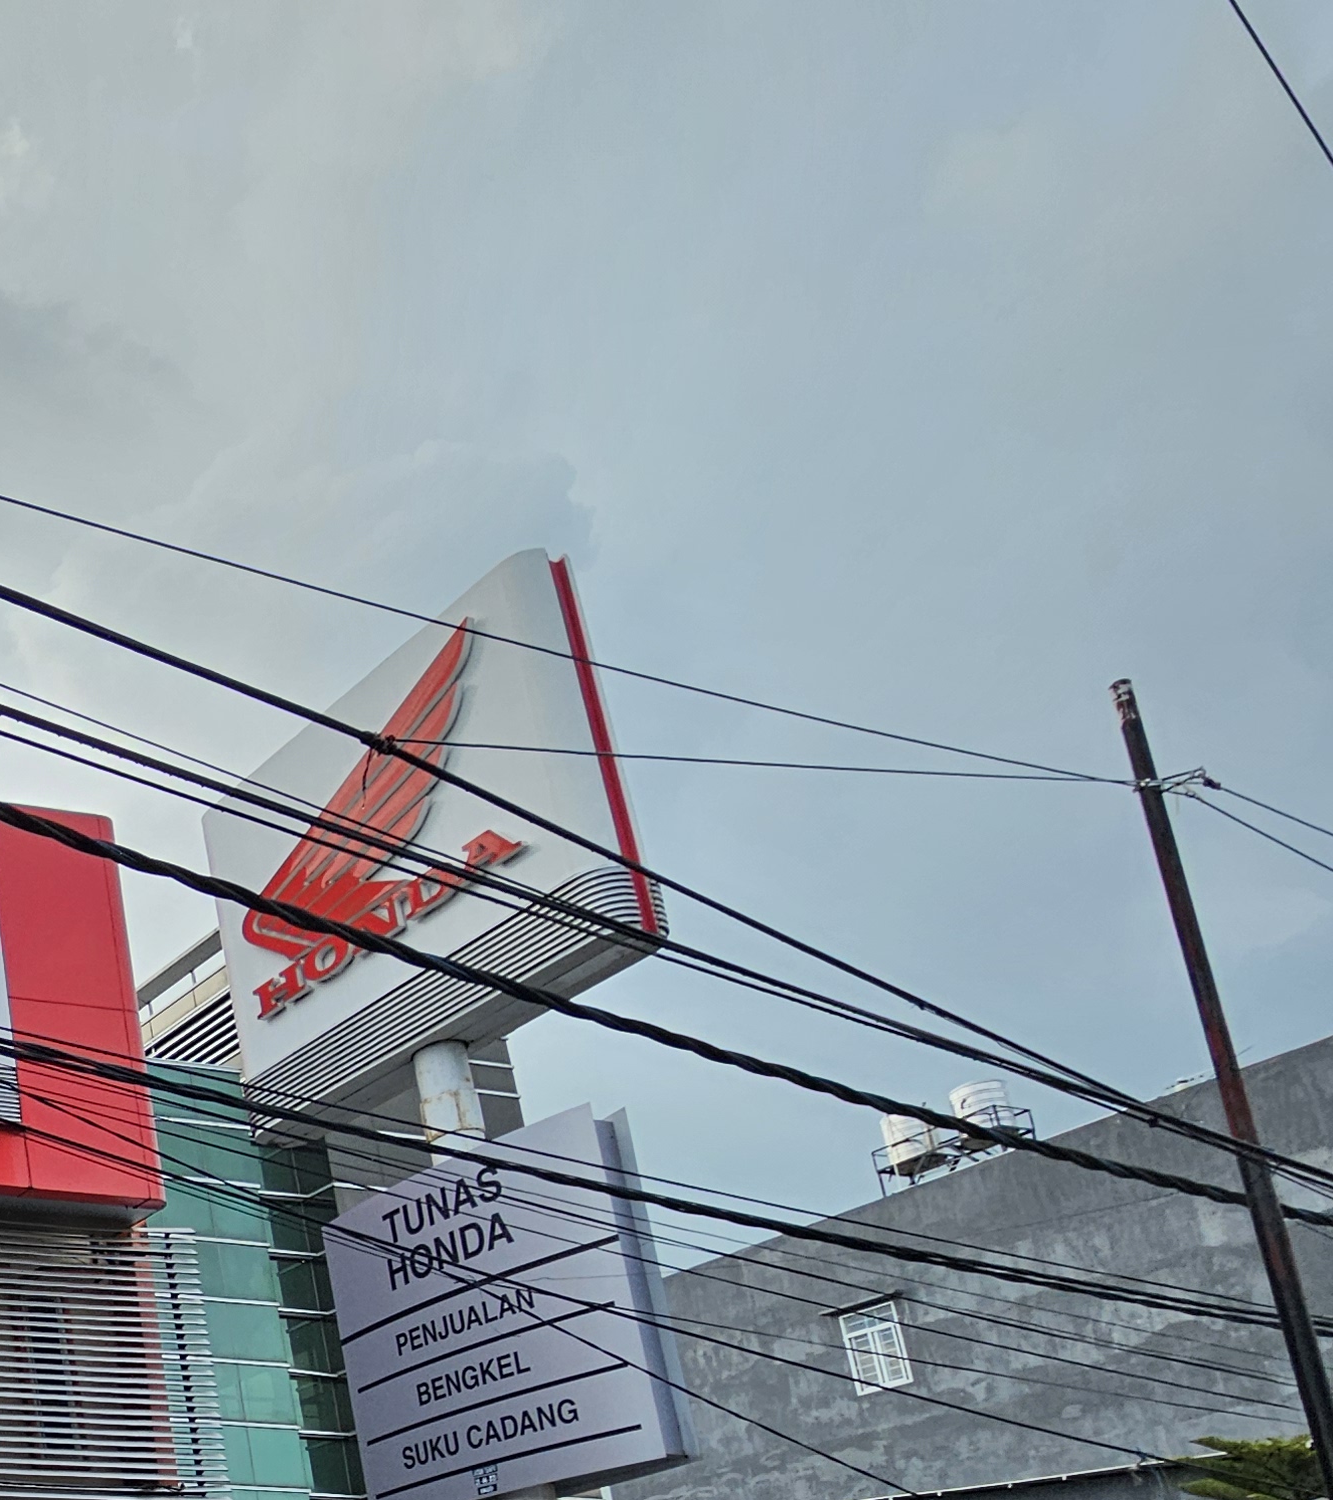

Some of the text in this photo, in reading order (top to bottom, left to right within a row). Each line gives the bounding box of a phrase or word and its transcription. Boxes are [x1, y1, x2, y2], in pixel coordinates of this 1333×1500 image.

[251, 829, 526, 1020] HONDA
[381, 1166, 504, 1243] TUNAS
[387, 1212, 514, 1291] HONDA
[395, 1287, 536, 1356] PENJUALAN
[415, 1350, 531, 1407] BENGKEL
[402, 1398, 579, 1470] SUKU CADANG
